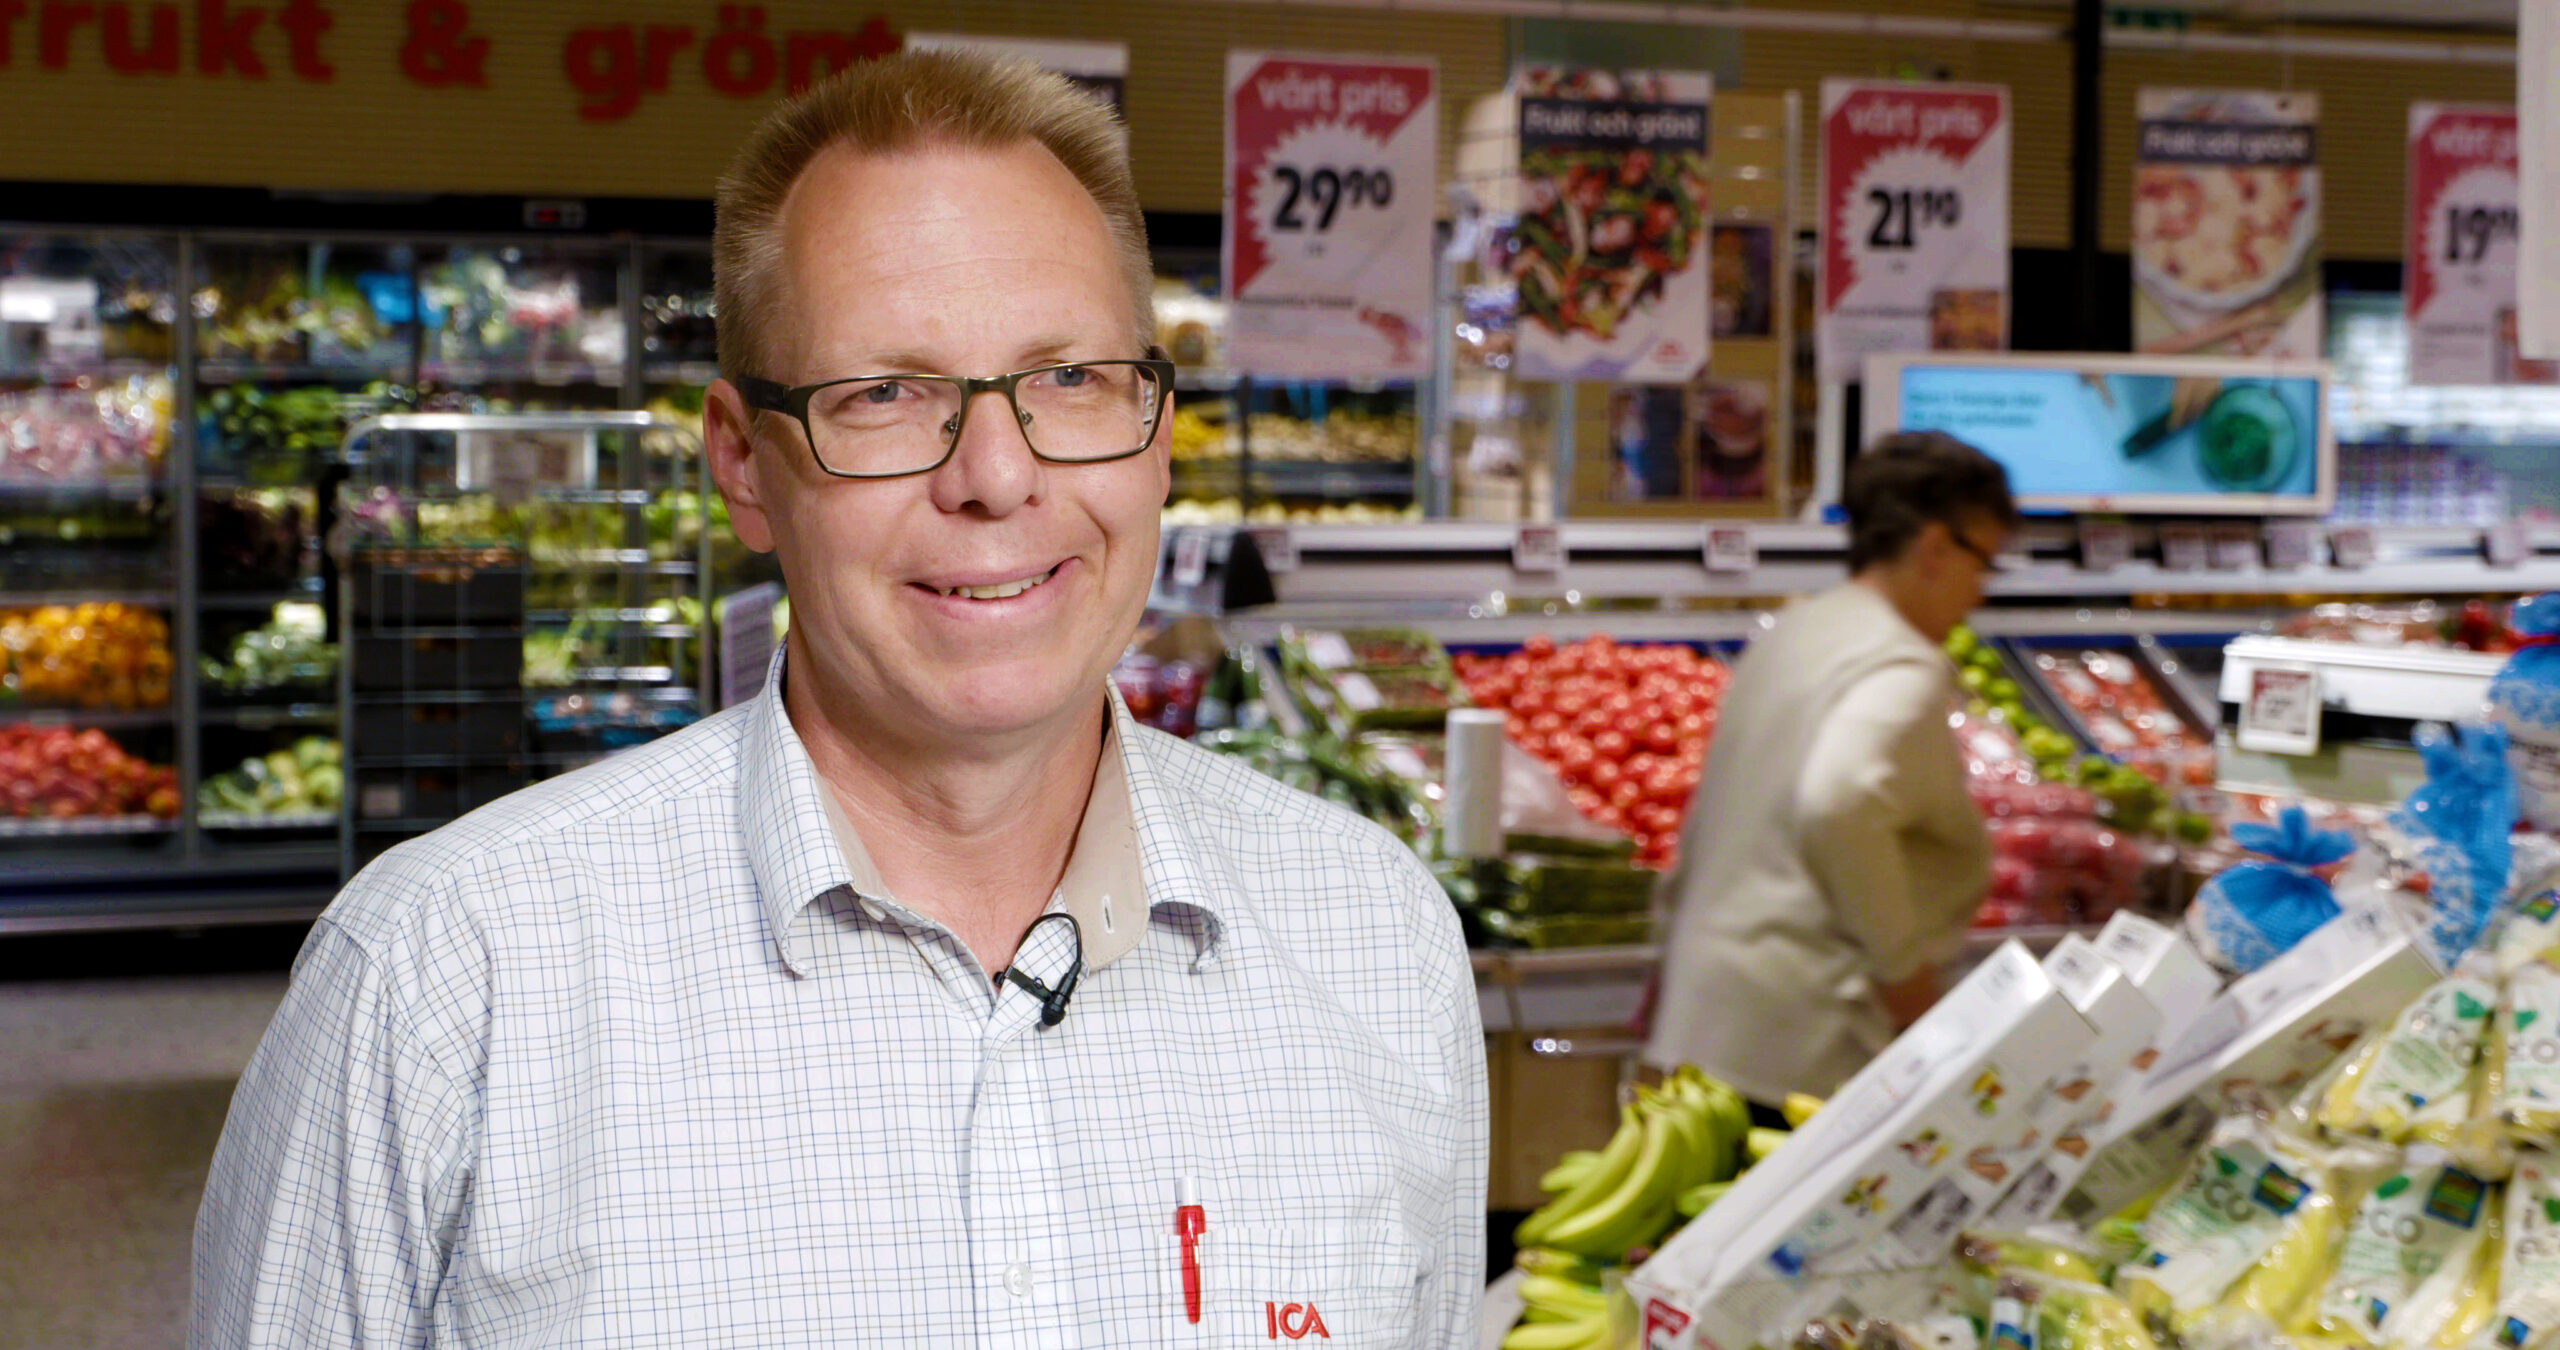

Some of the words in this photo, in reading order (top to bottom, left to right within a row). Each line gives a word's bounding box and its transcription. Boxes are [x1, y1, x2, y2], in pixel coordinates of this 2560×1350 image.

[402, 0, 490, 87] &
[1588, 109, 1630, 137] och
[1265, 1301, 1330, 1340] ICA
